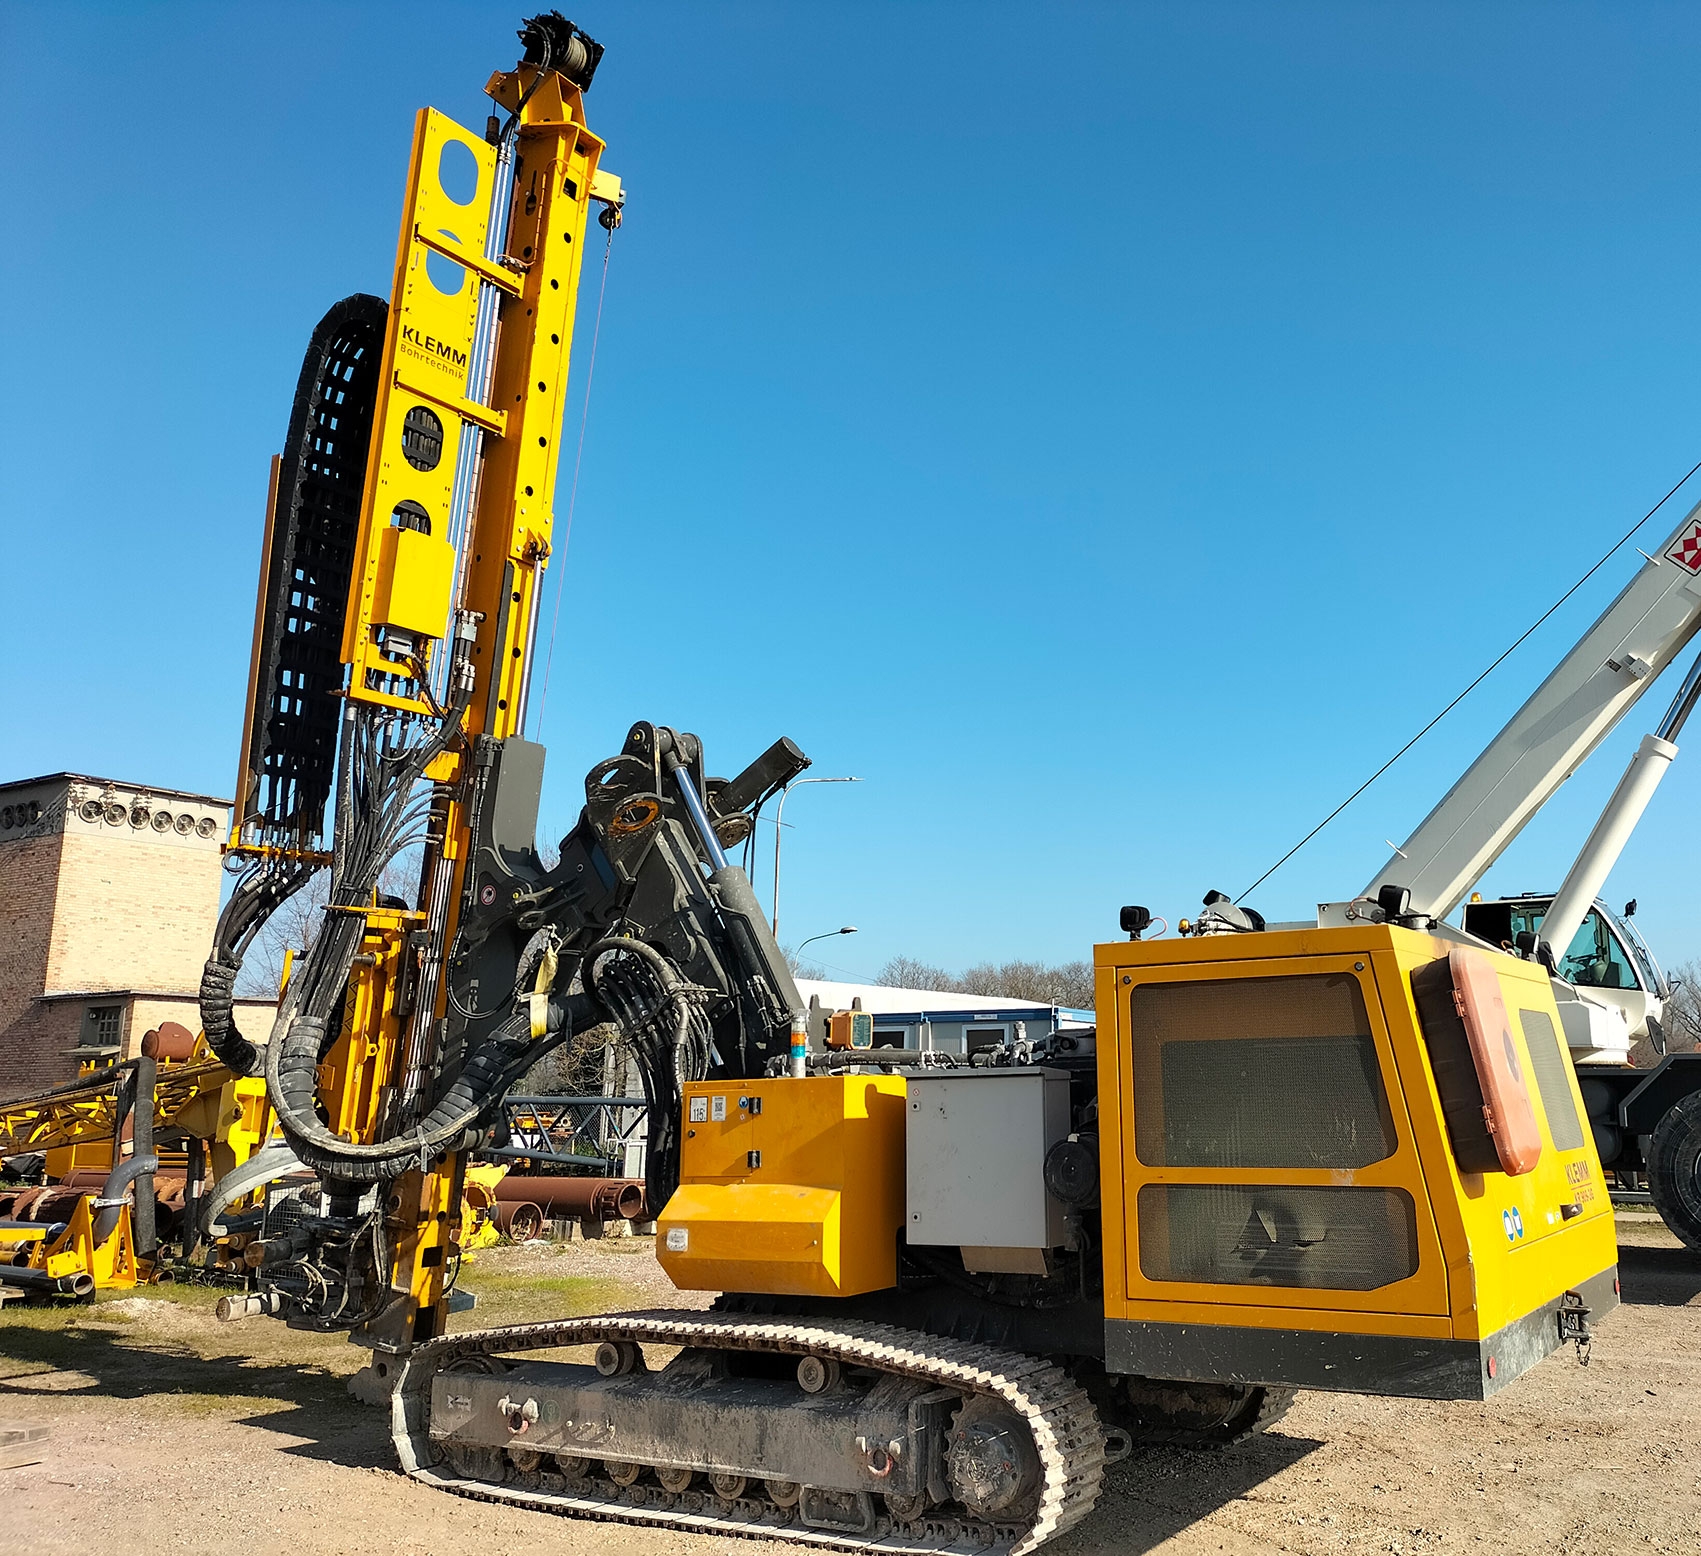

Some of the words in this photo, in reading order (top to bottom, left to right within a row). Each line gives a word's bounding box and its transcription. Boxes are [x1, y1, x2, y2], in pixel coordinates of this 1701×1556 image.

[400, 344, 464, 380] Bohrtechnik
[403, 325, 466, 367] KLEMM
[1564, 1160, 1590, 1185] KLEMM
